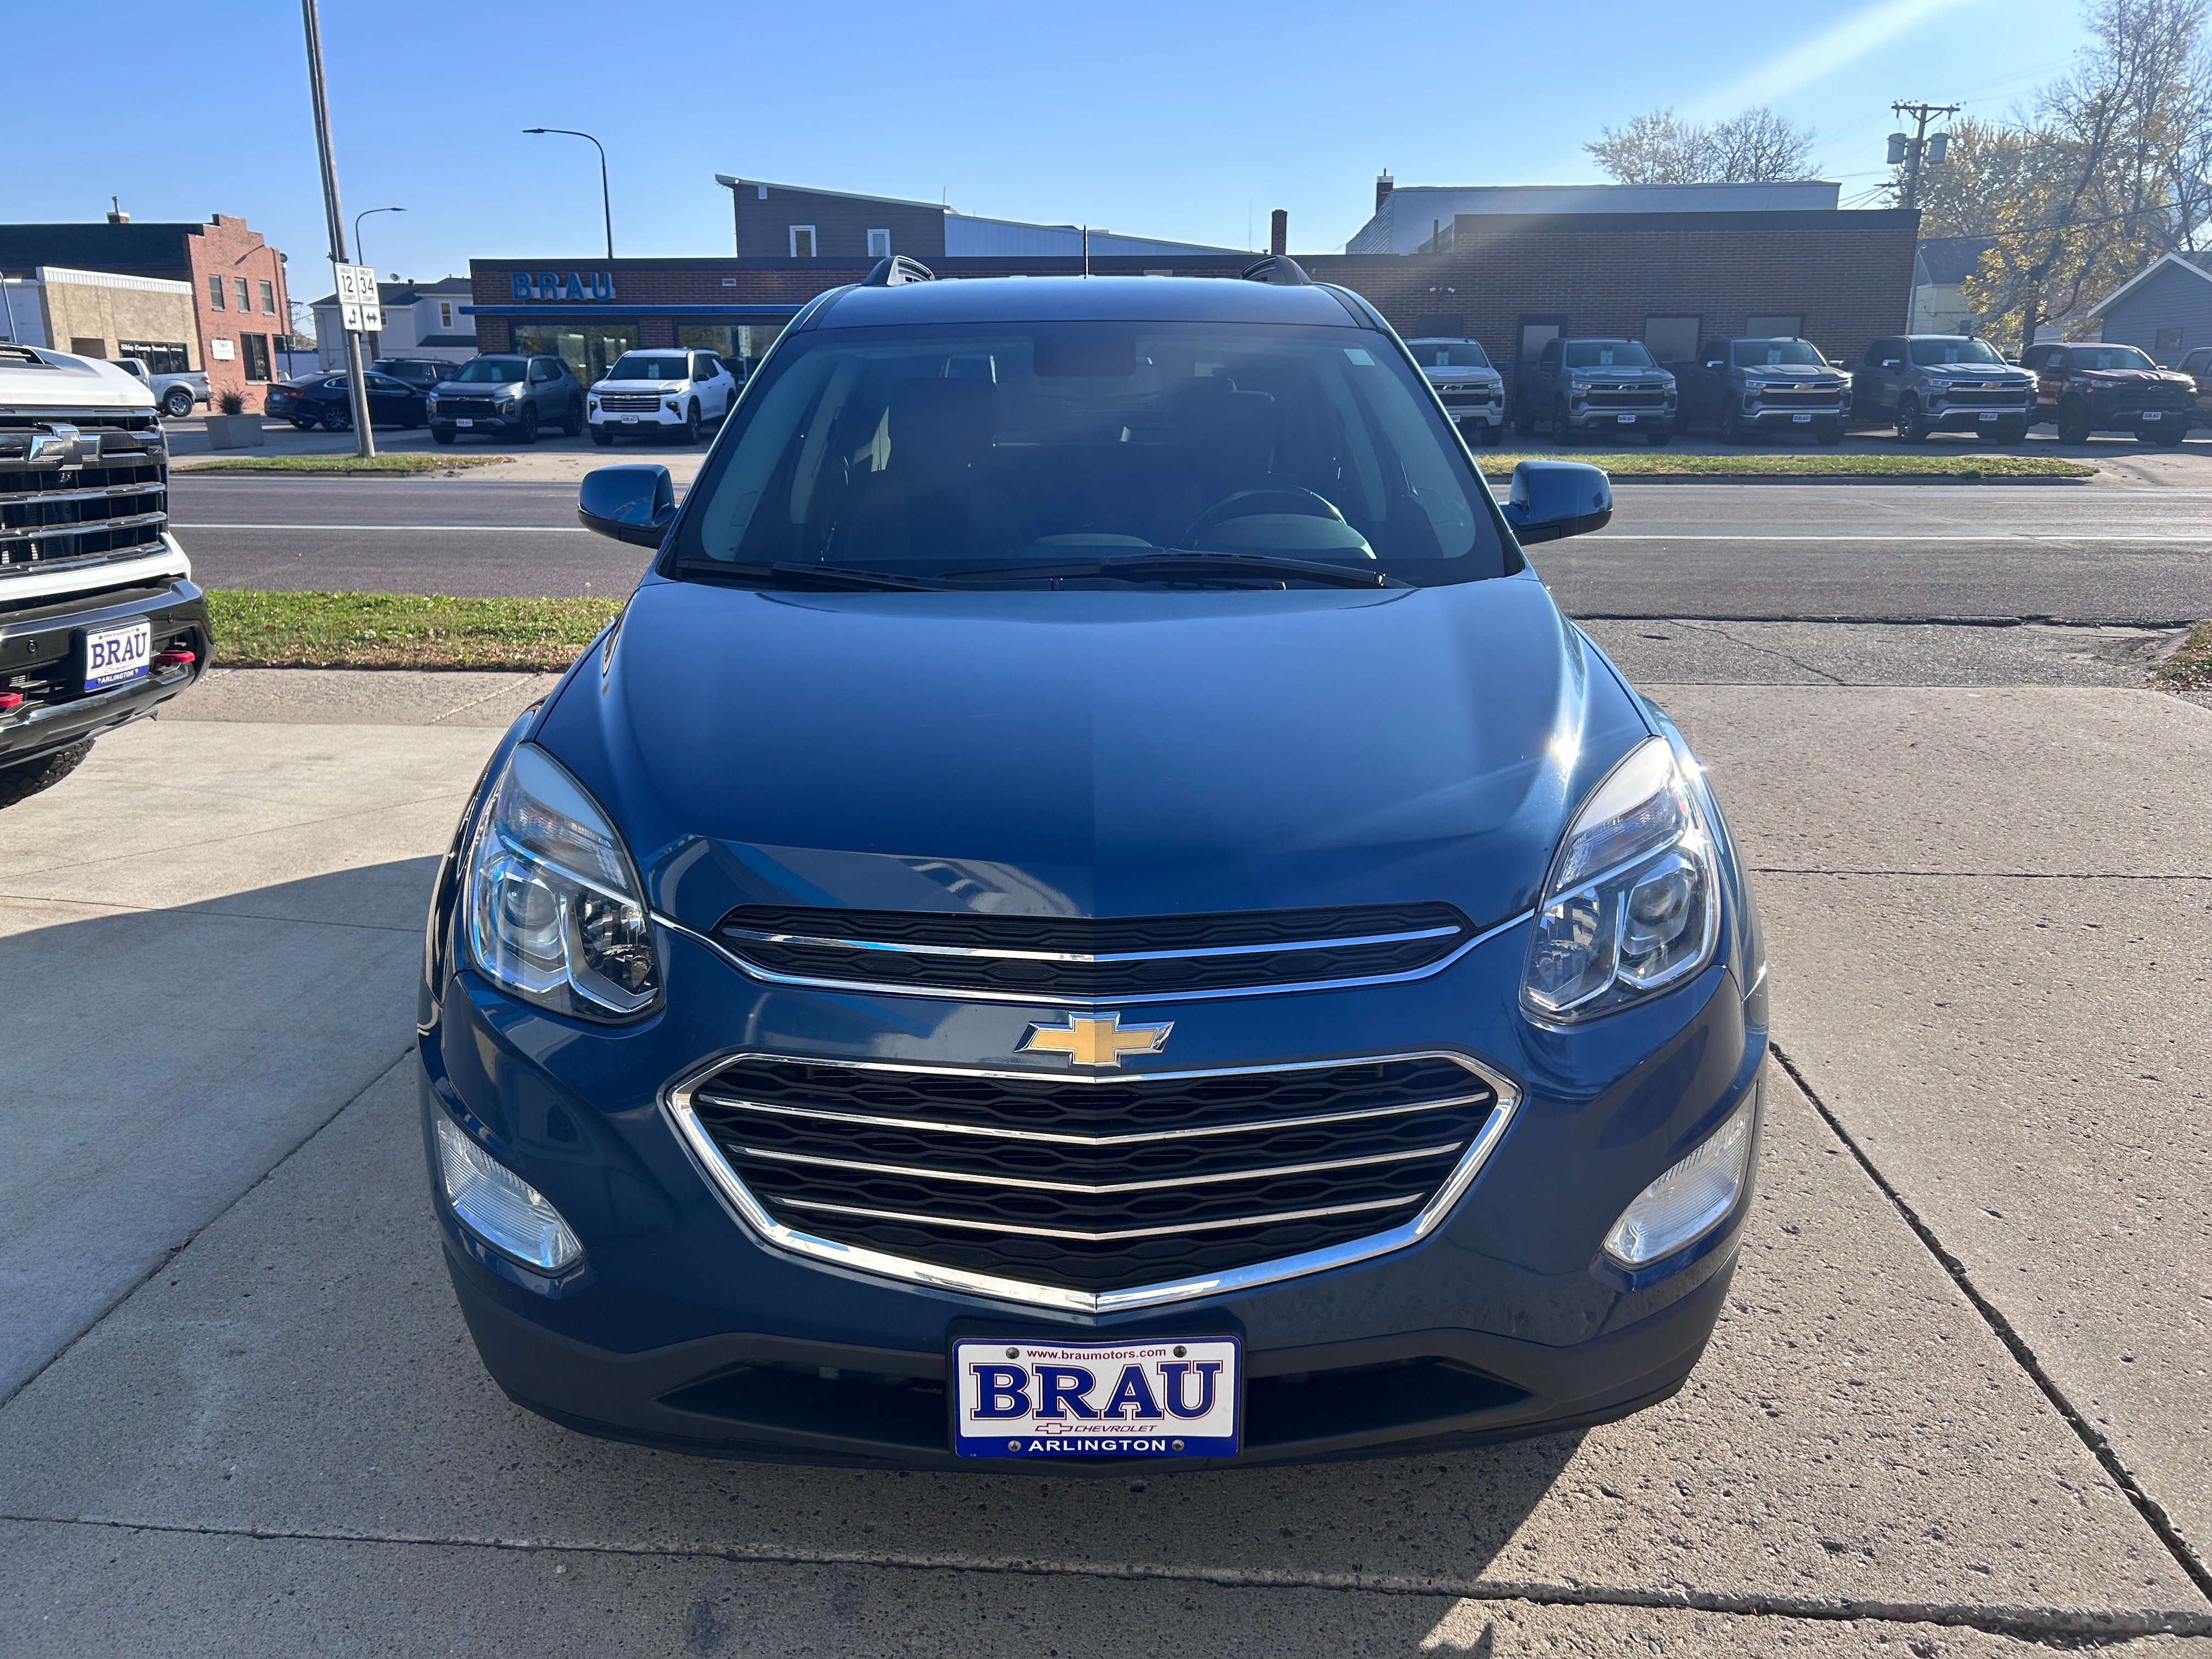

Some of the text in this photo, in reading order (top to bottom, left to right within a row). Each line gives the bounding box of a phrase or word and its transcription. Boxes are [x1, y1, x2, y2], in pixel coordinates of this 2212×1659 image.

[342, 275, 354, 293] 12
[360, 276, 374, 295] 34
[512, 272, 612, 301] BRAU
[134, 344, 151, 352] County
[91, 631, 147, 670] BRAU
[101, 669, 134, 684] ARLINGTON
[1027, 1348, 1166, 1360] www.braumotors.com
[969, 1359, 1223, 1421] BRAU
[1028, 1440, 1166, 1452] ARLINGTON
